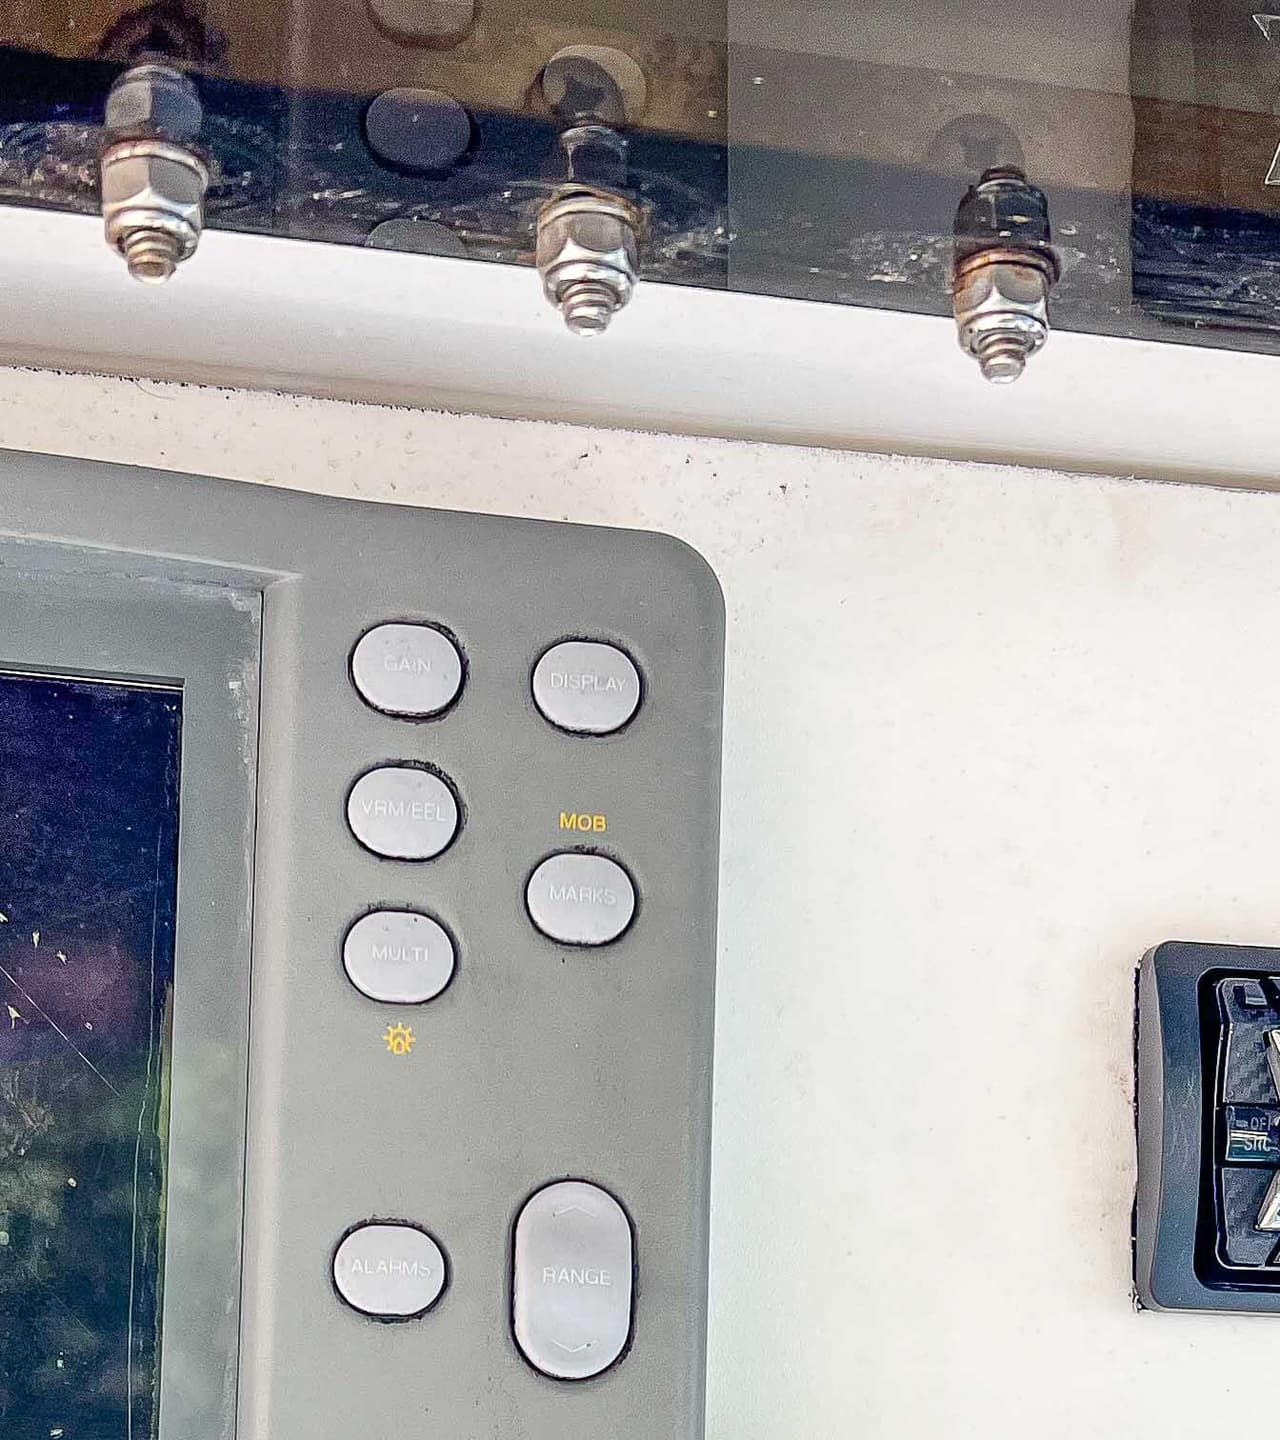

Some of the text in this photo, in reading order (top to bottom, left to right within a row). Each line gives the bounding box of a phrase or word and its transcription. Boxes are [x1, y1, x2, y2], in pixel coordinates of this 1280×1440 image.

[383, 655, 432, 674] GAIN
[549, 672, 627, 693] DISPLAY
[559, 812, 607, 832] MOB
[548, 885, 617, 905] MARKS
[371, 944, 429, 962] MULTI
[351, 1258, 431, 1279] ALARMS
[542, 1266, 612, 1287] RANGE
